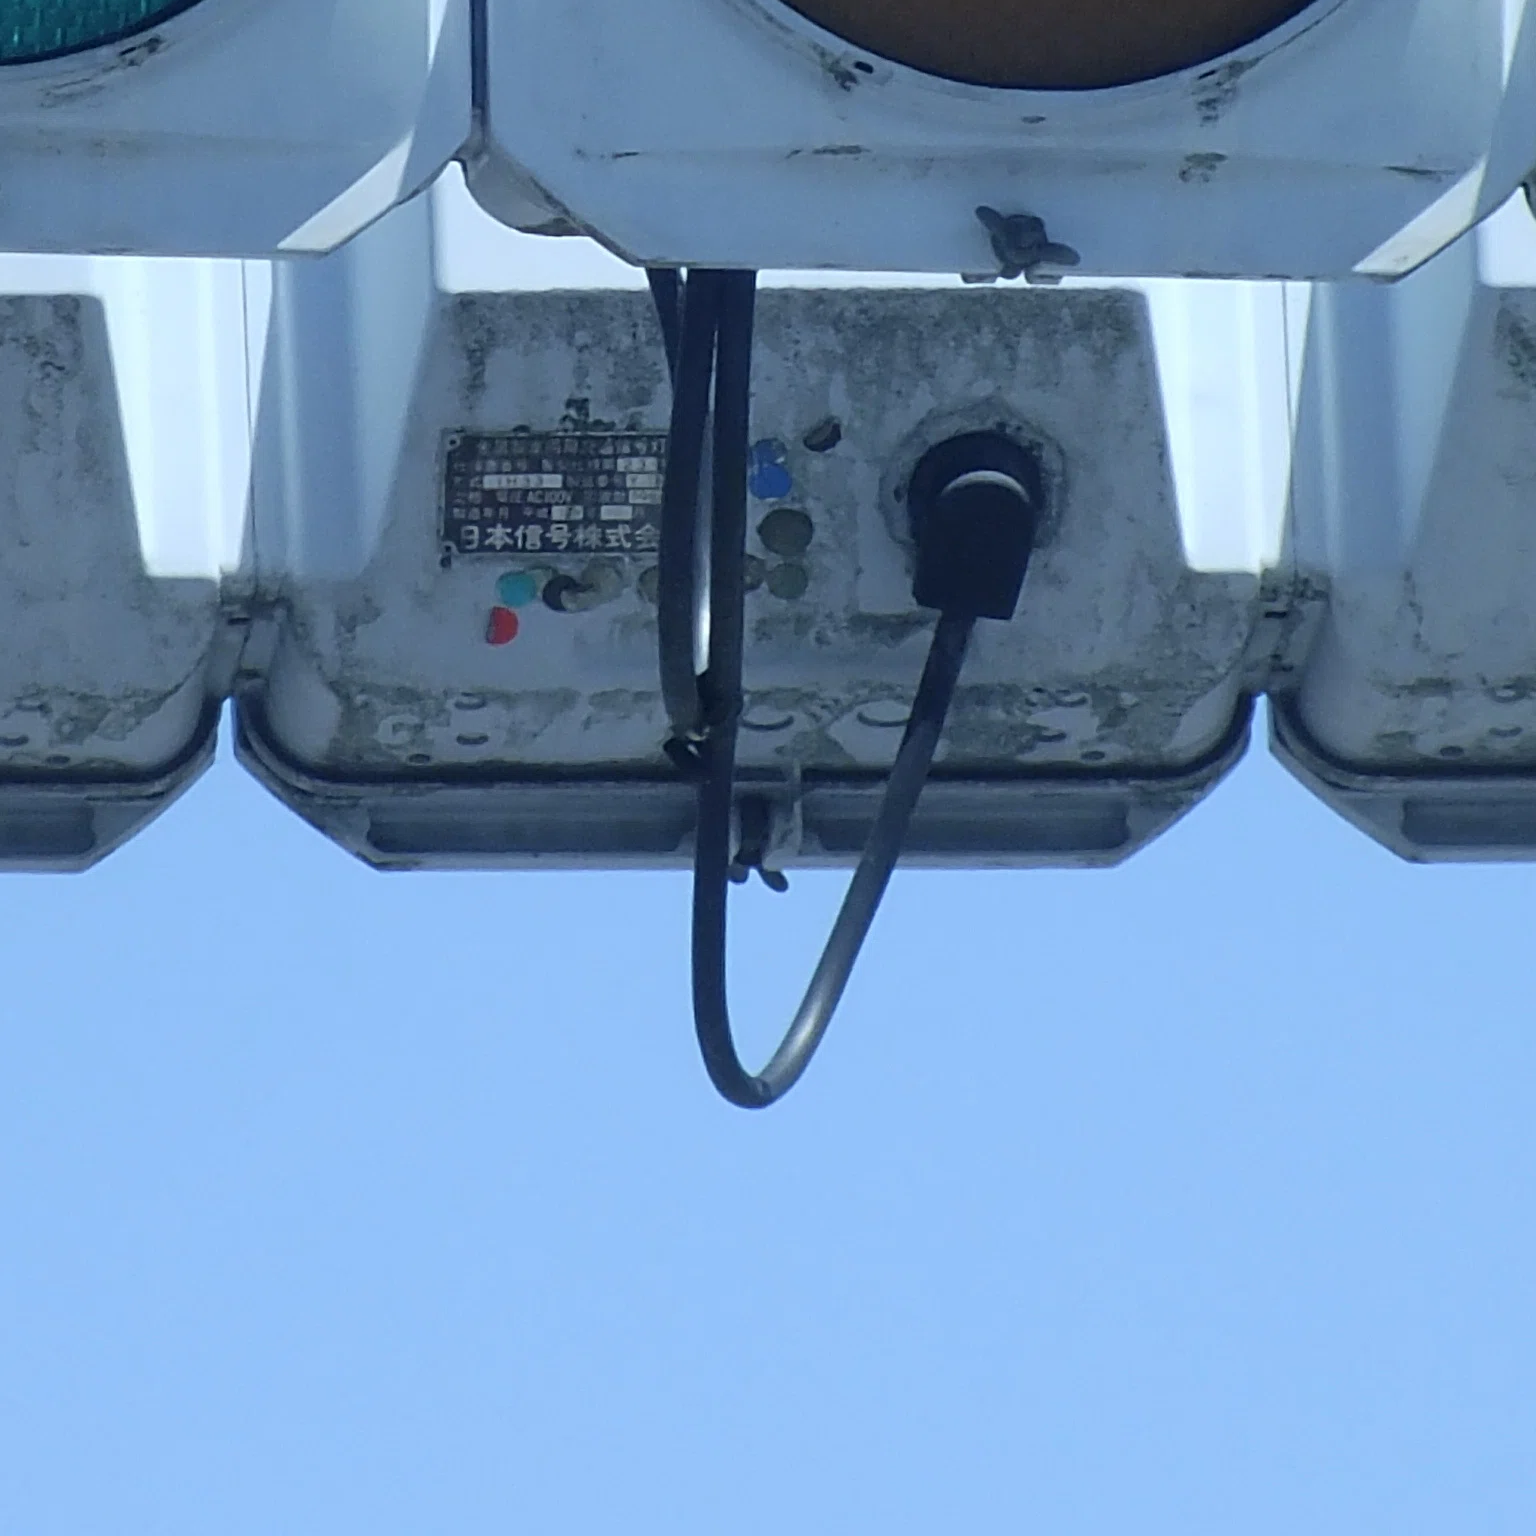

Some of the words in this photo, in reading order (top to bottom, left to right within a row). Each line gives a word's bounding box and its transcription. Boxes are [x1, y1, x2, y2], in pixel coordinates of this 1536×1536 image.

[460, 523, 661, 551] 日本信号株式会
